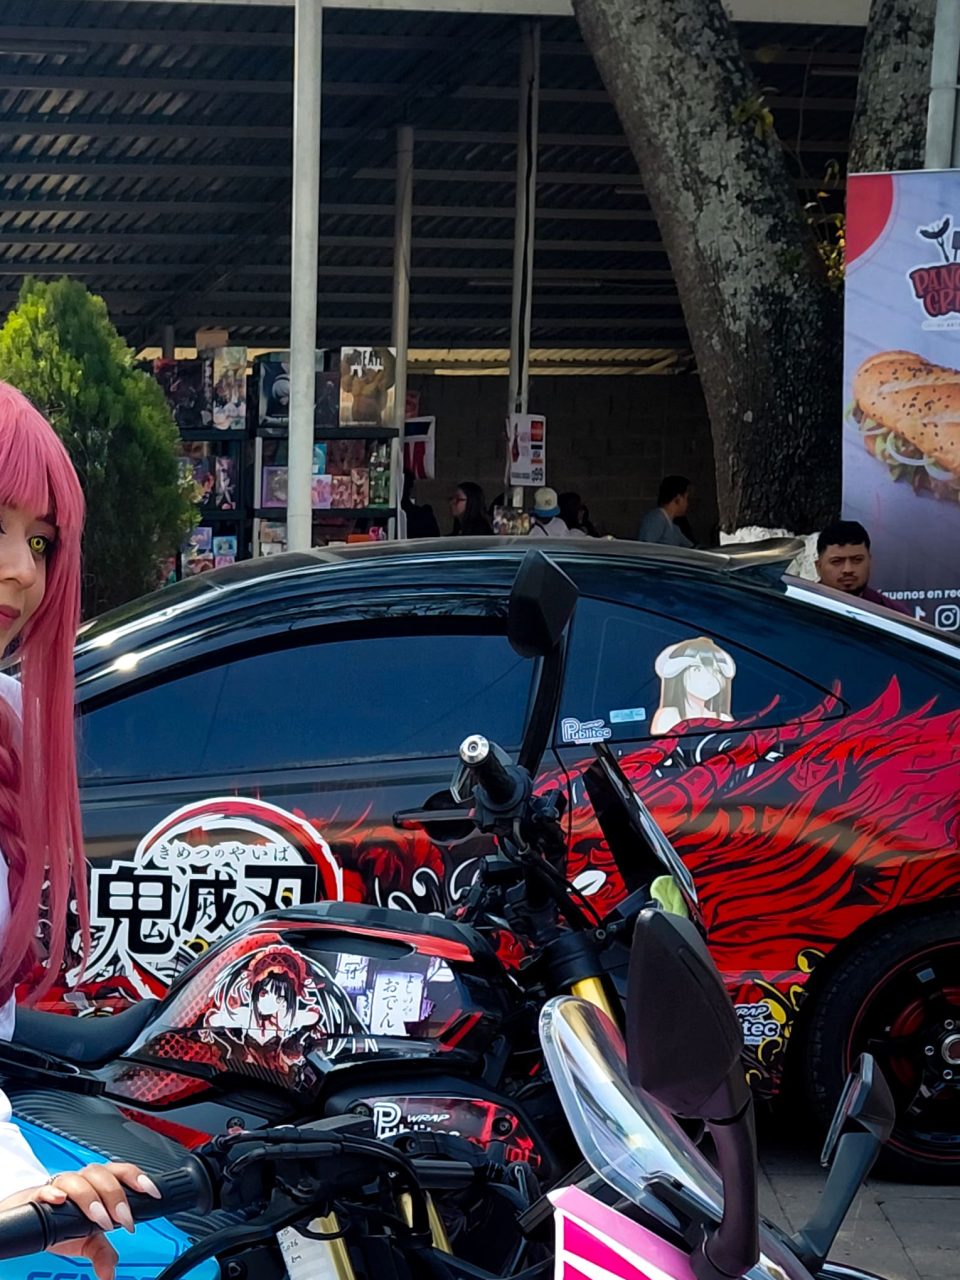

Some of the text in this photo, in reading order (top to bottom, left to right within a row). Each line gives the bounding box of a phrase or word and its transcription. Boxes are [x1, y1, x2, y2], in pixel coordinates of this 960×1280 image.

[927, 591, 942, 599] en
[563, 719, 612, 740] Publitec
[159, 845, 290, 862] きめつのやいば
[379, 977, 400, 1029] おでん
[407, 1113, 451, 1123] WRAP
